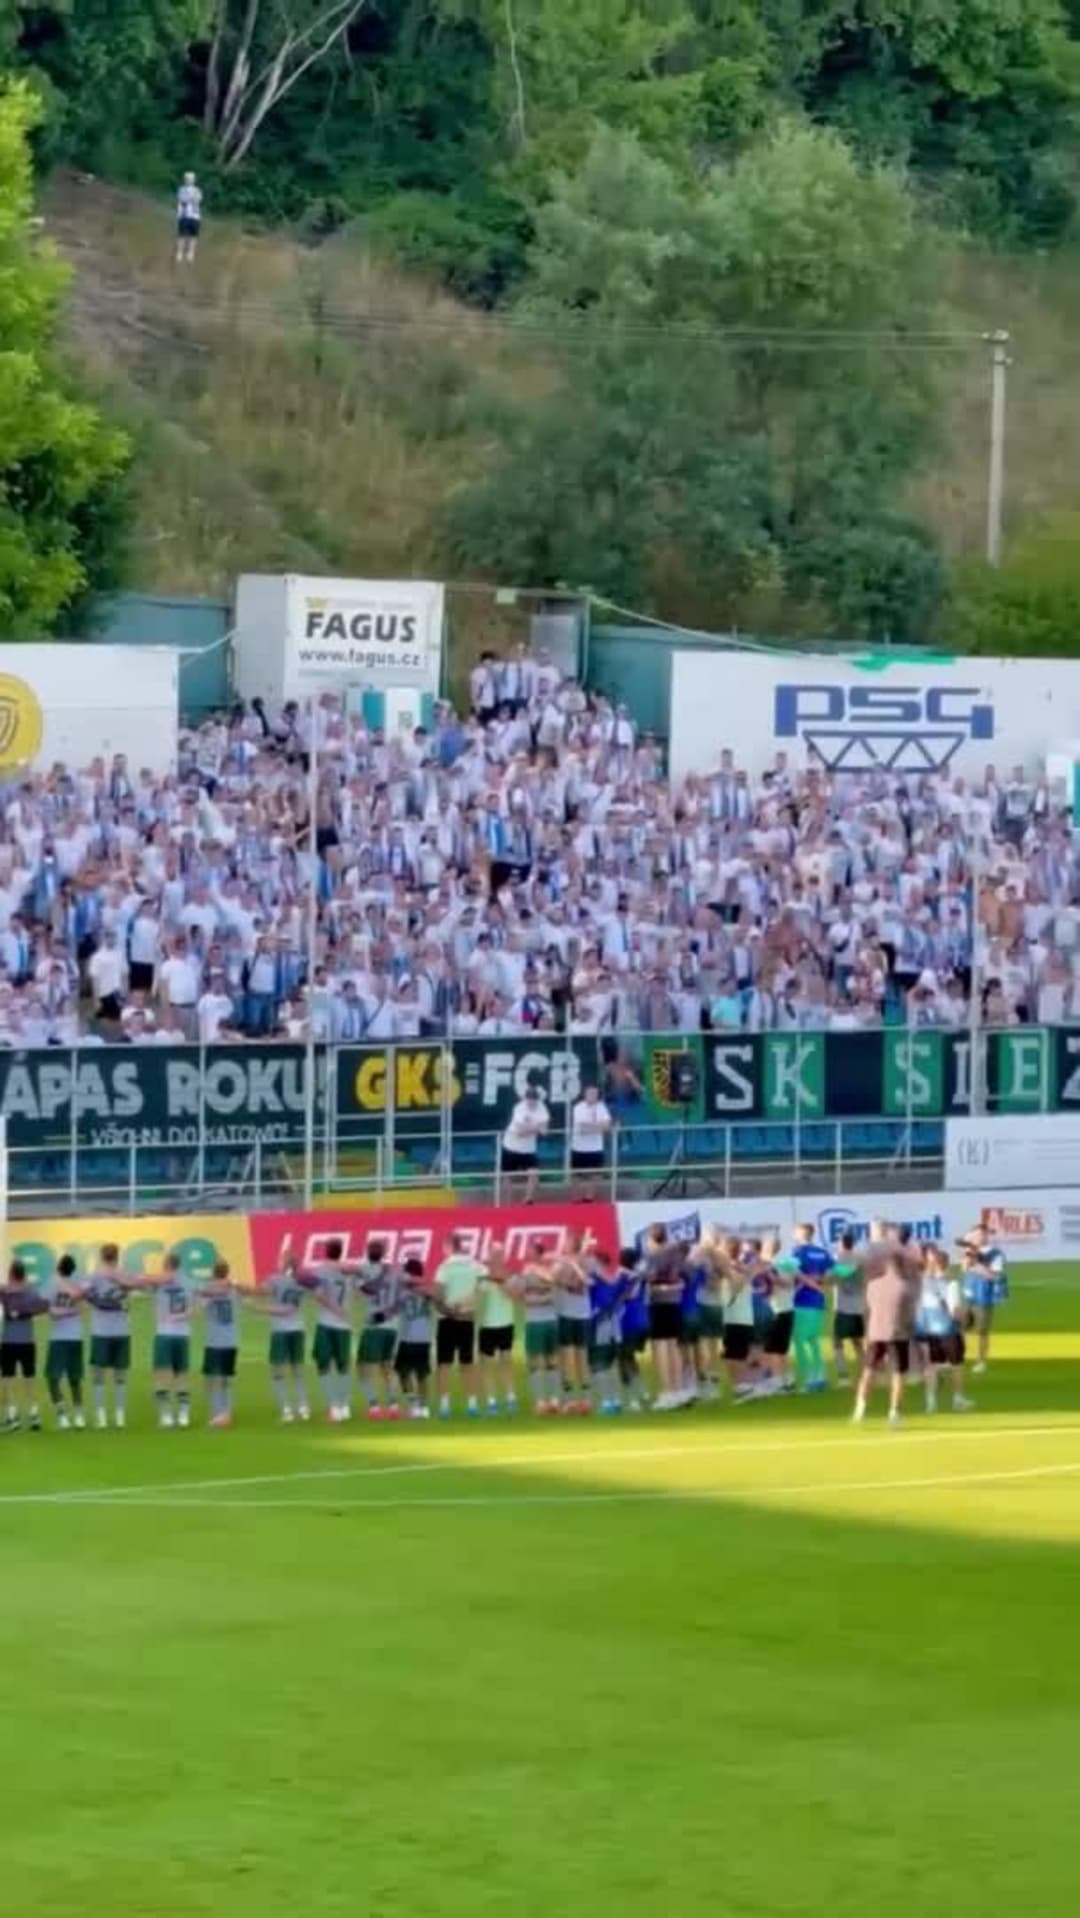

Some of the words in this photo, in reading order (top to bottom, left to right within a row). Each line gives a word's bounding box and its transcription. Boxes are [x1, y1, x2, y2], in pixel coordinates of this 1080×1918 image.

[305, 612, 417, 643] FAGUS
[298, 648, 422, 668] www.fagus.cz
[356, 1052, 461, 1109] GKS
[483, 1050, 581, 1105] FCB
